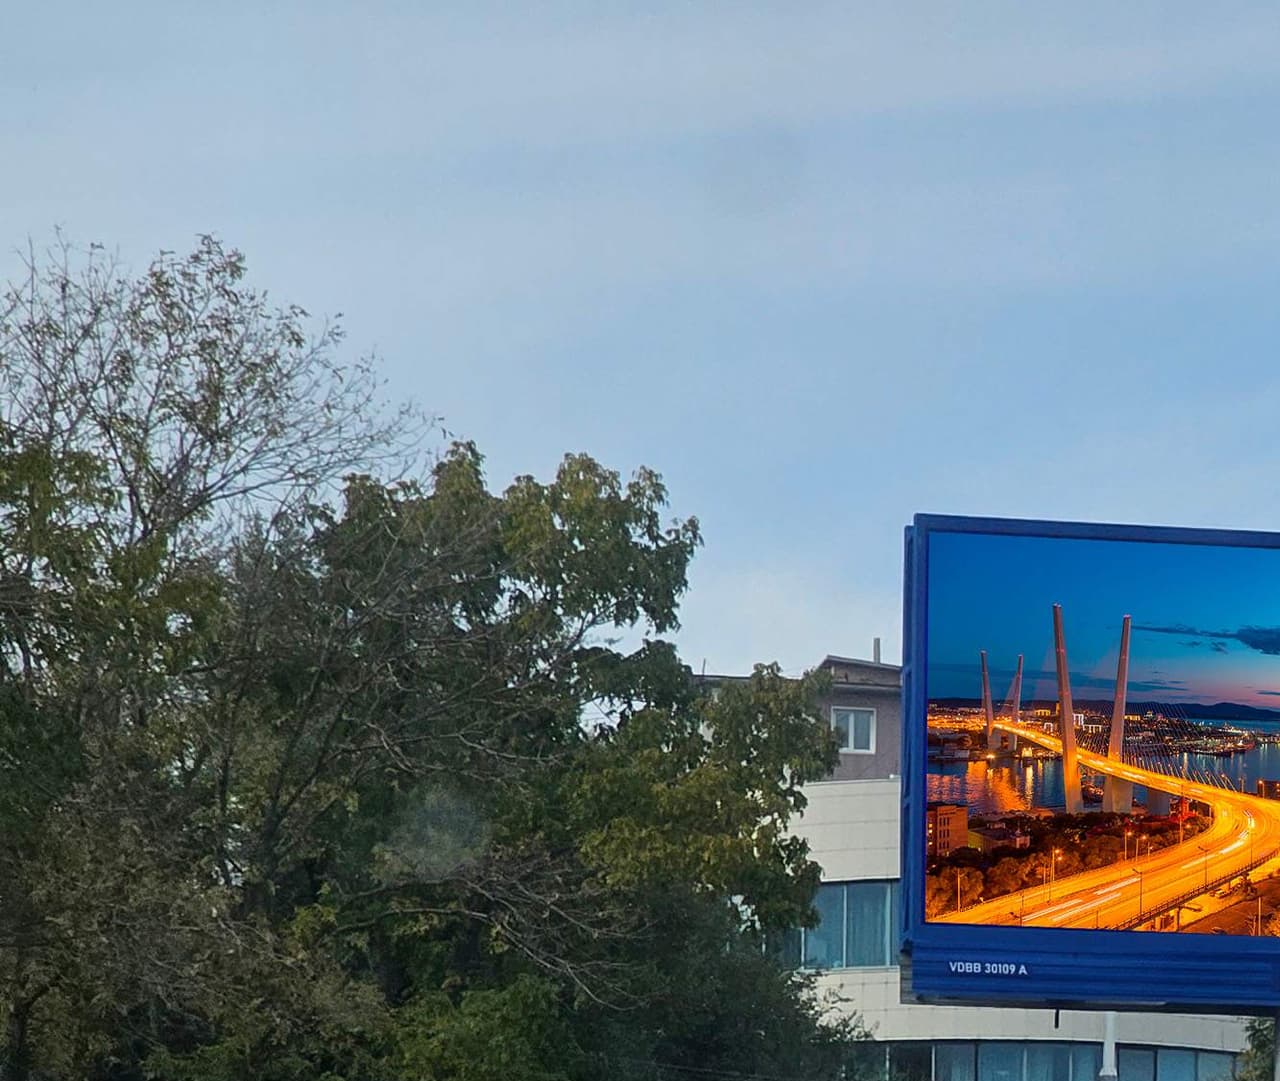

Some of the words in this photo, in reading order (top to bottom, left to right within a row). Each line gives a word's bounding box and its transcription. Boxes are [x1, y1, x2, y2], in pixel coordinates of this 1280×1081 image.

[949, 962, 981, 973] VDBB
[984, 963, 1016, 975] 30109
[1018, 965, 1028, 975] A
